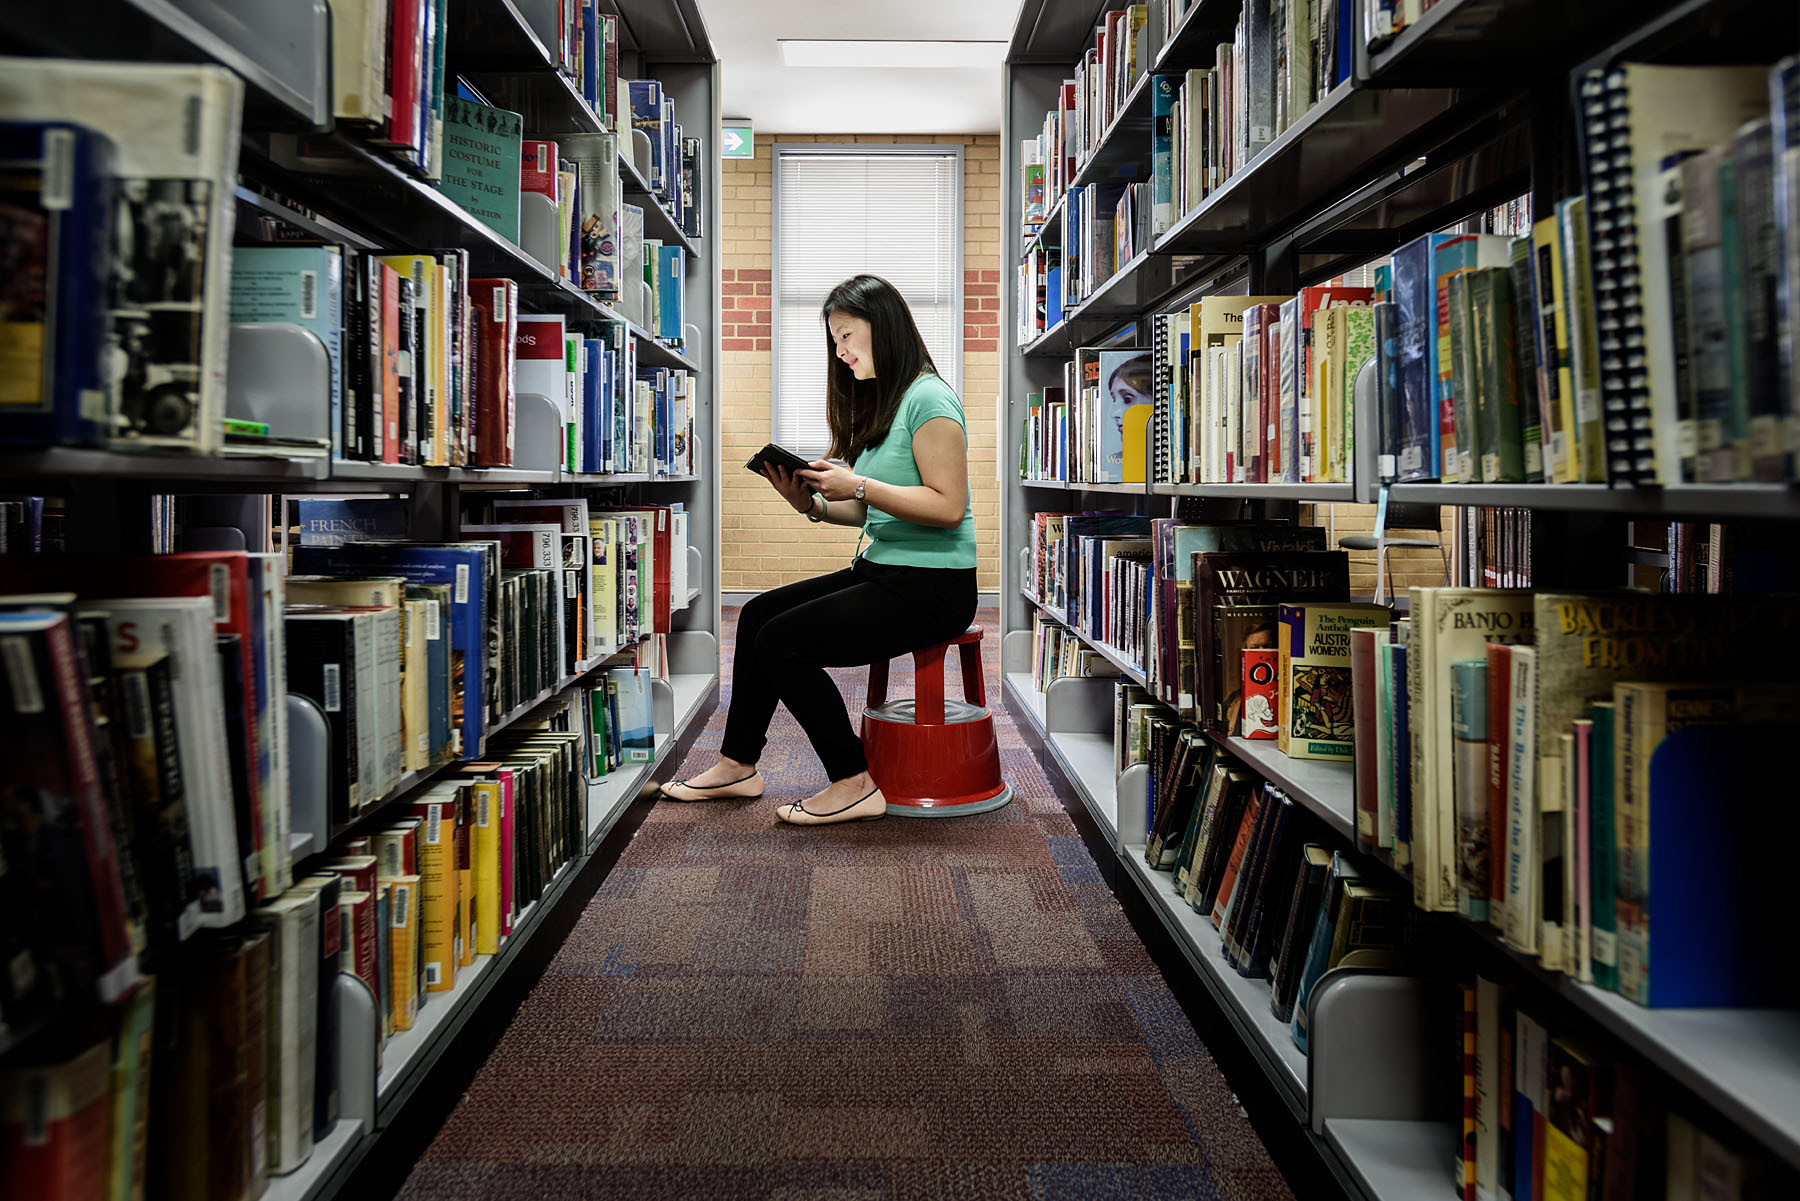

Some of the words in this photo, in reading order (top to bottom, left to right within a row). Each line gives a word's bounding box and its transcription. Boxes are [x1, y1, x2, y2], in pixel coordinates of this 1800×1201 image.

[449, 134, 502, 156] HISTORIC
[448, 149, 502, 170] COSTUME
[467, 167, 484, 178] FOR
[445, 174, 468, 188] THE
[471, 180, 505, 196] STAGE
[471, 195, 480, 204] by
[470, 206, 503, 220] BARTON
[370, 275, 381, 356] THEATRE
[1223, 312, 1243, 323] The
[311, 518, 377, 532] FRENCH
[541, 533, 551, 567] 796.333
[1216, 569, 1328, 589] WAGNER
[1320, 615, 1336, 624] The
[1337, 615, 1375, 626] Penguin
[1412, 602, 1423, 640] HAPPY
[1454, 612, 1512, 631] BANJO
[1309, 645, 1348, 657] WOMEN'S
[1583, 637, 1669, 669] FROM
[1515, 704, 1527, 736] The
[1512, 741, 1525, 791] Banjo
[1512, 795, 1523, 816] of
[1511, 818, 1522, 846] the
[1509, 851, 1521, 896] Bush
